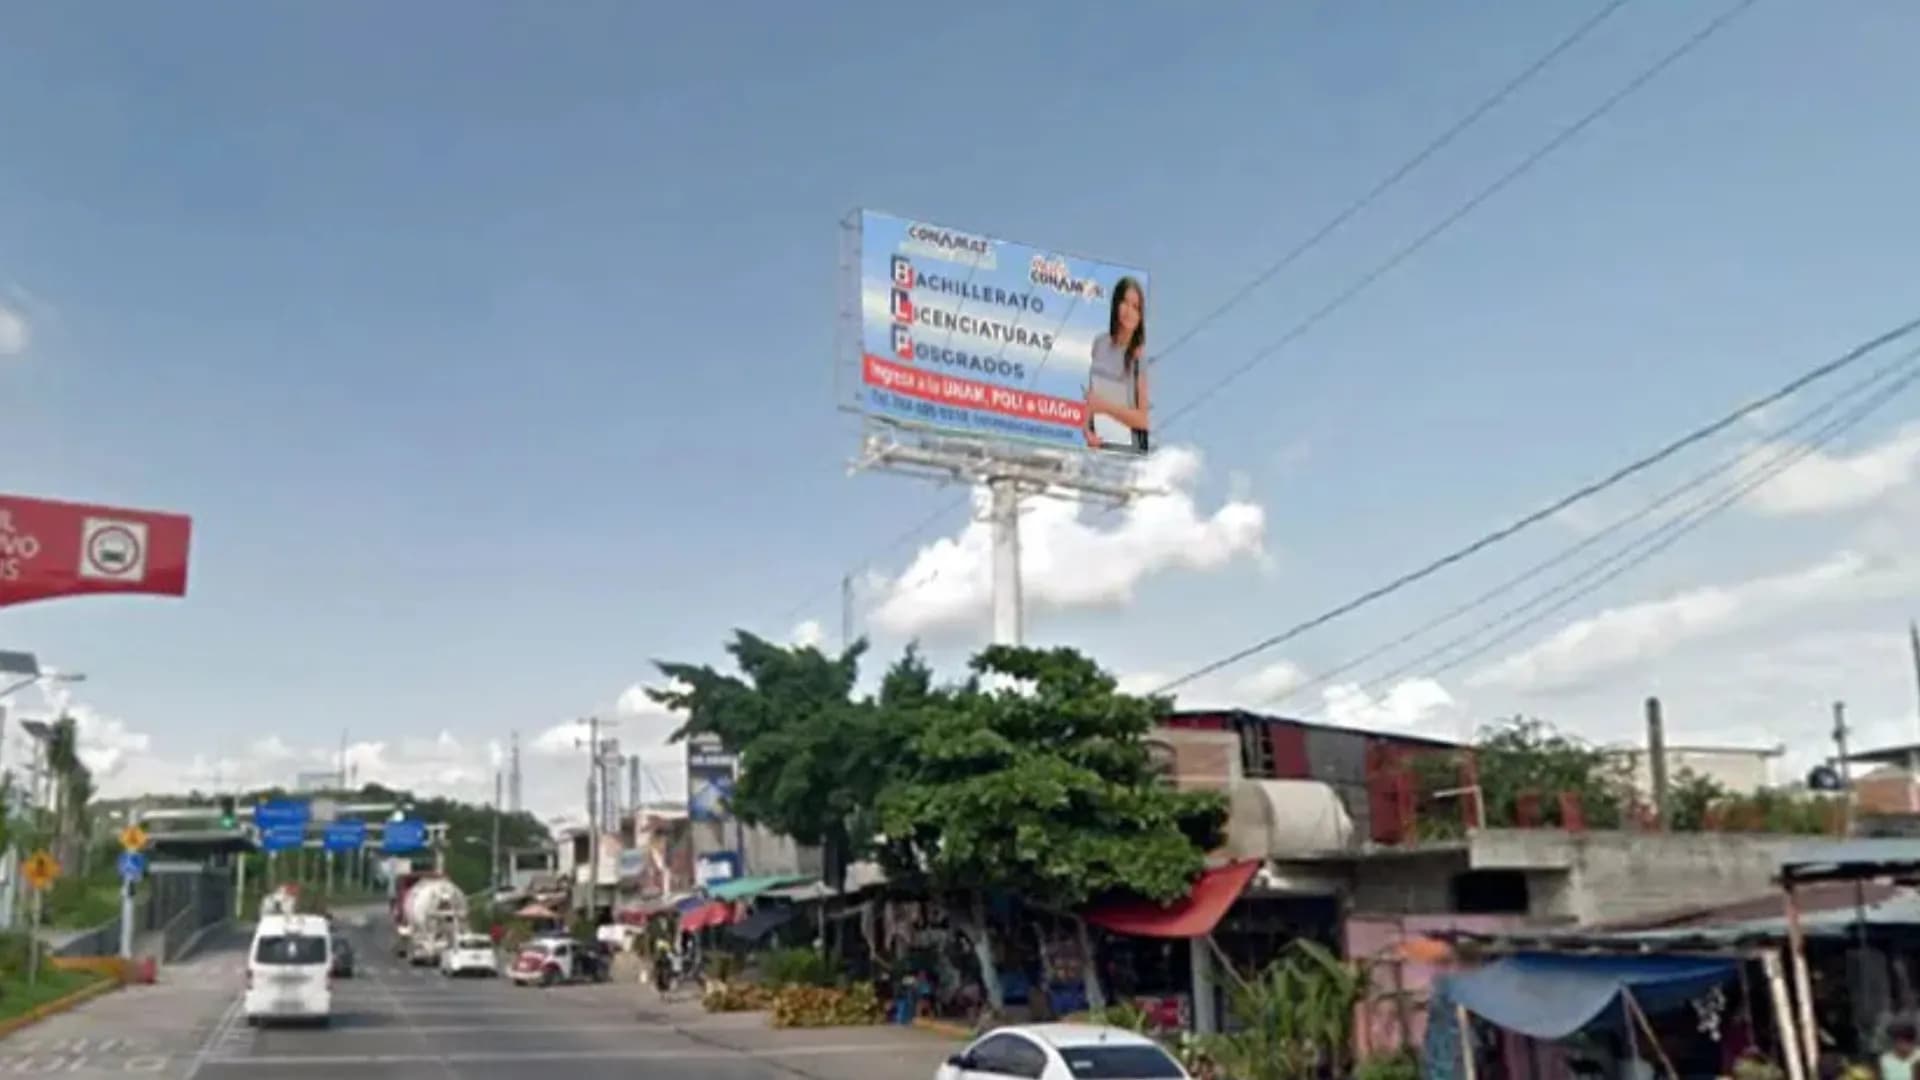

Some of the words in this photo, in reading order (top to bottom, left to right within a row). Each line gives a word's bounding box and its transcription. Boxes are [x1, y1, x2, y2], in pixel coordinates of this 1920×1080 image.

[892, 258, 1044, 313] BACHILLERATO
[892, 291, 1054, 350] LICENCIATURAS
[892, 328, 1025, 380] POSGRADOS
